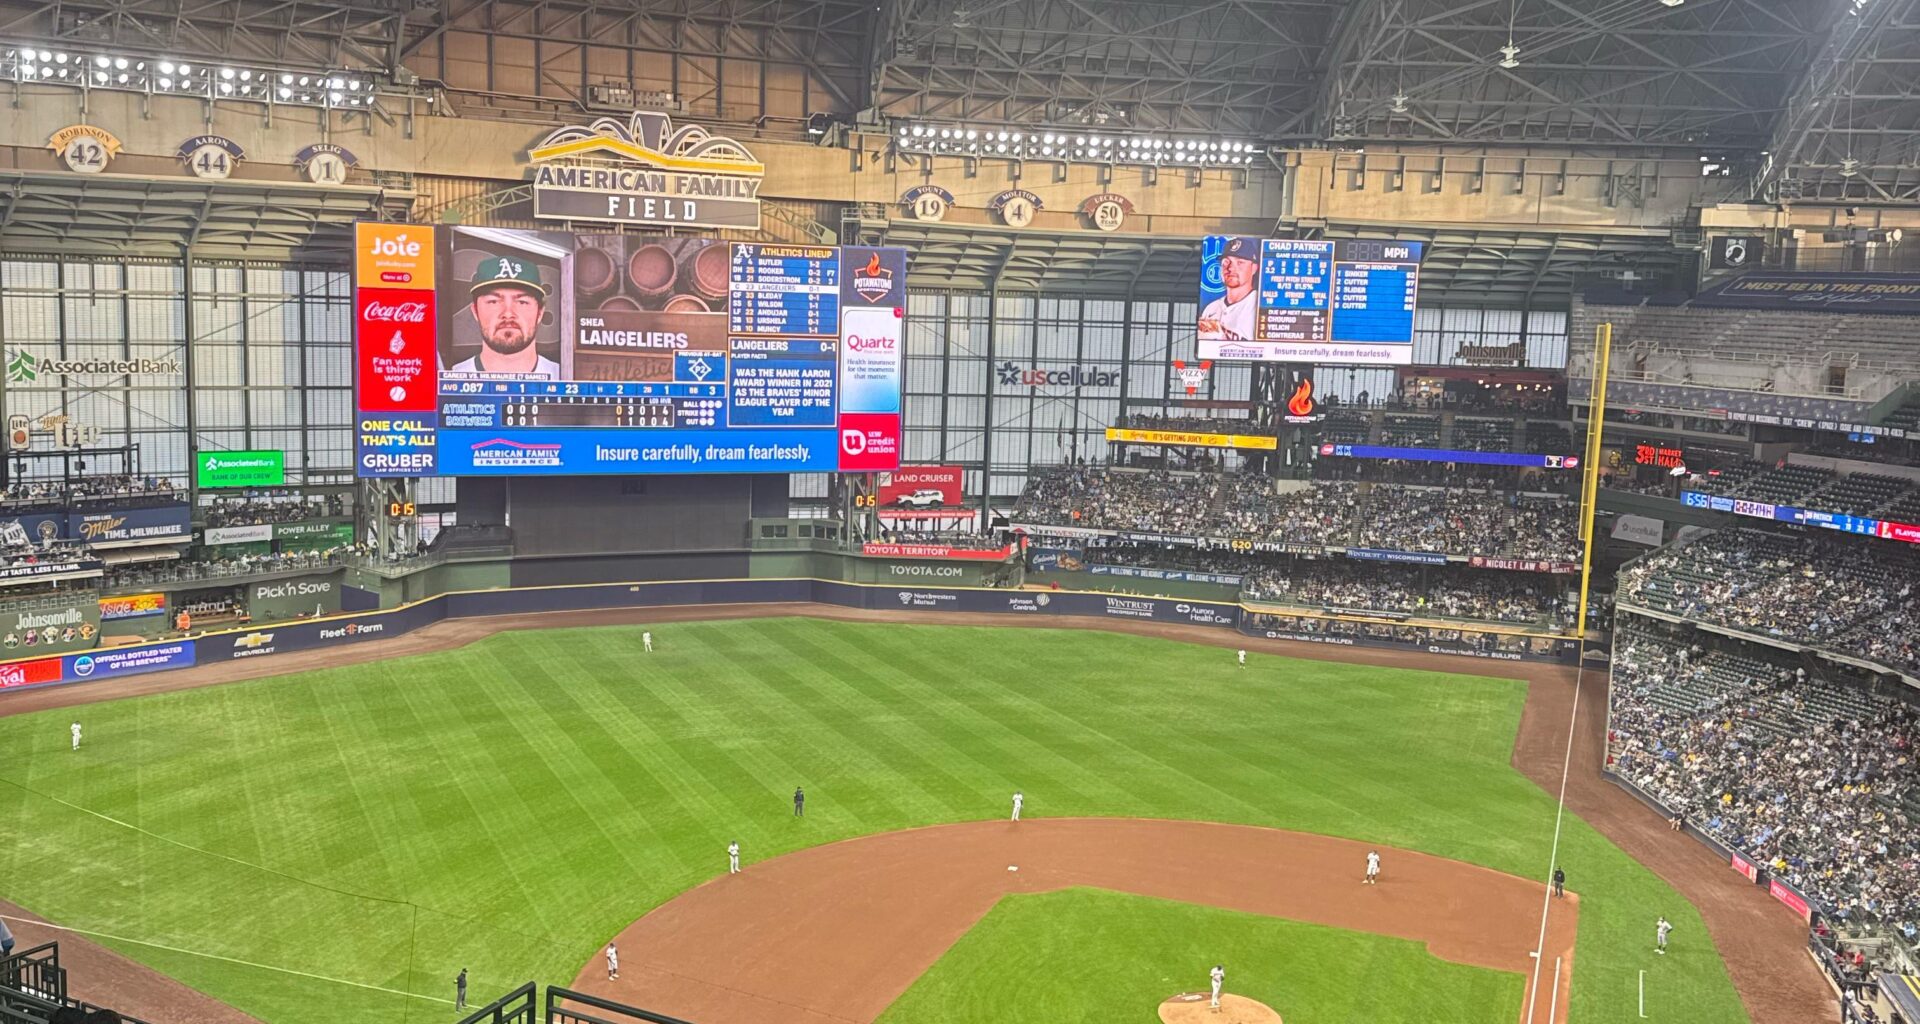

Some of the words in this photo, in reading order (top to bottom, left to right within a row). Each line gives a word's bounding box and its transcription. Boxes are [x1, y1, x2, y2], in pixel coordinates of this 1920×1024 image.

[58, 124, 112, 143] ROBINSON
[194, 136, 230, 149] AARON
[311, 143, 342, 154] SELIG
[71, 143, 102, 166] 42
[197, 152, 227, 173] 44
[322, 160, 333, 180] 1
[537, 165, 667, 194] AMERICAN
[675, 175, 762, 198] FAMILY
[917, 187, 944, 196] YOUNT
[1001, 192, 1037, 203] MOLITOR
[1094, 195, 1125, 204] UECKER
[608, 196, 696, 220] FIELD
[920, 199, 940, 217] 19
[1011, 205, 1023, 221] 4
[1100, 206, 1118, 219] 50
[370, 233, 421, 257] Joie
[735, 243, 754, 258] A's
[760, 248, 803, 258] ATHLETICS
[804, 250, 833, 258] LINEUP
[1293, 244, 1327, 252] PATRICK
[1384, 247, 1409, 258] MPH
[494, 258, 522, 279] A's
[758, 276, 801, 284] SODERSTROM
[854, 278, 892, 290] POTAWATOMI
[1743, 282, 1788, 290] MUST
[1785, 283, 1808, 291] BE
[1807, 284, 1829, 292] IN
[1828, 284, 1864, 292] THE
[1861, 284, 1920, 294] FRONT
[363, 301, 428, 323] Coca-Cola
[580, 318, 604, 327] SHEA
[580, 329, 689, 349] LANGELIERS
[847, 334, 895, 352] Quartz
[731, 340, 788, 351] LANGELIERS
[820, 342, 836, 352] 0-1
[1455, 341, 1526, 359] Johnsonville
[1274, 347, 1297, 356] Insure
[1299, 348, 1331, 358] carefully,
[1332, 349, 1355, 357] dream
[1356, 349, 1392, 359] fearlessly.
[40, 358, 139, 375] Associated
[140, 358, 181, 375] Bank
[372, 357, 393, 366] Fan
[395, 357, 422, 366] work
[374, 365, 383, 373] is
[385, 365, 421, 375] thirsty
[736, 369, 756, 377] WAS
[758, 369, 774, 377] THE
[776, 369, 799, 378] HANK
[801, 369, 830, 378] AARON
[1022, 365, 1121, 387] uscellular
[1178, 369, 1207, 377] VIZZY
[384, 374, 412, 382] work
[733, 379, 765, 387] AWARD
[767, 379, 801, 387] WINNER
[460, 383, 484, 393] .087
[565, 384, 579, 394] 23
[767, 389, 801, 397] BRAVES'
[803, 389, 831, 397] MINOR
[735, 398, 767, 406] LEAGUE
[769, 398, 800, 406] PLAYER
[442, 404, 496, 415] ATHLETICS
[772, 408, 794, 416] YEAR
[361, 420, 391, 431] ONE
[392, 420, 435, 432] CALL...
[446, 416, 493, 426] BREWERS
[361, 435, 406, 446] THAT'S
[408, 435, 435, 446] ALL!
[868, 437, 895, 445] credit
[1164, 434, 1186, 442] GETTING
[1187, 435, 1203, 443] JUICY
[473, 450, 523, 458] AMERICAN
[526, 450, 560, 459] FAMILY
[595, 444, 639, 461] Insure
[642, 445, 702, 464] carefully,
[705, 445, 746, 461] dream
[749, 443, 812, 462] fearlessly.
[362, 454, 434, 468] GRUBER
[894, 474, 918, 483] LAND
[919, 474, 954, 483] CRUISER
[856, 495, 876, 507] 0:15
[391, 503, 414, 516] 0:15
[79, 517, 127, 540] Miller
[104, 530, 129, 540] TIME,
[130, 525, 182, 537] MILWAUKEE
[278, 527, 305, 535] POWER
[306, 524, 330, 533] ALLEY
[865, 545, 899, 555] TOYOTA
[902, 547, 950, 556] TERRITORY
[1231, 540, 1252, 549] 620
[1253, 542, 1286, 552] WTMJ
[1347, 550, 1381, 558] WINTRUST
[1387, 554, 1427, 562] WISCONSIN'S
[10, 567, 33, 576] TASTE.
[34, 566, 51, 574] LESS
[53, 563, 80, 572] FILLING.
[890, 565, 963, 577] TOYOTA.COM
[1486, 559, 1517, 571] NICOLET
[1520, 562, 1536, 571] LAW
[257, 586, 285, 599] Pick
[298, 582, 331, 595] Save
[1106, 597, 1154, 610] WINTRUST
[1190, 607, 1214, 615] Aurora
[16, 608, 82, 630] Johnsonville
[1190, 614, 1213, 622] Health
[320, 628, 346, 639] Fleet
[358, 623, 383, 634] Farm
[1325, 637, 1353, 645] BULLPEN
[95, 653, 126, 663] OFFICIAL
[128, 650, 159, 660] BOTTLED
[159, 646, 182, 655] WATER
[234, 647, 275, 658] CHEVROLET
[1491, 652, 1521, 660] BULLPEN
